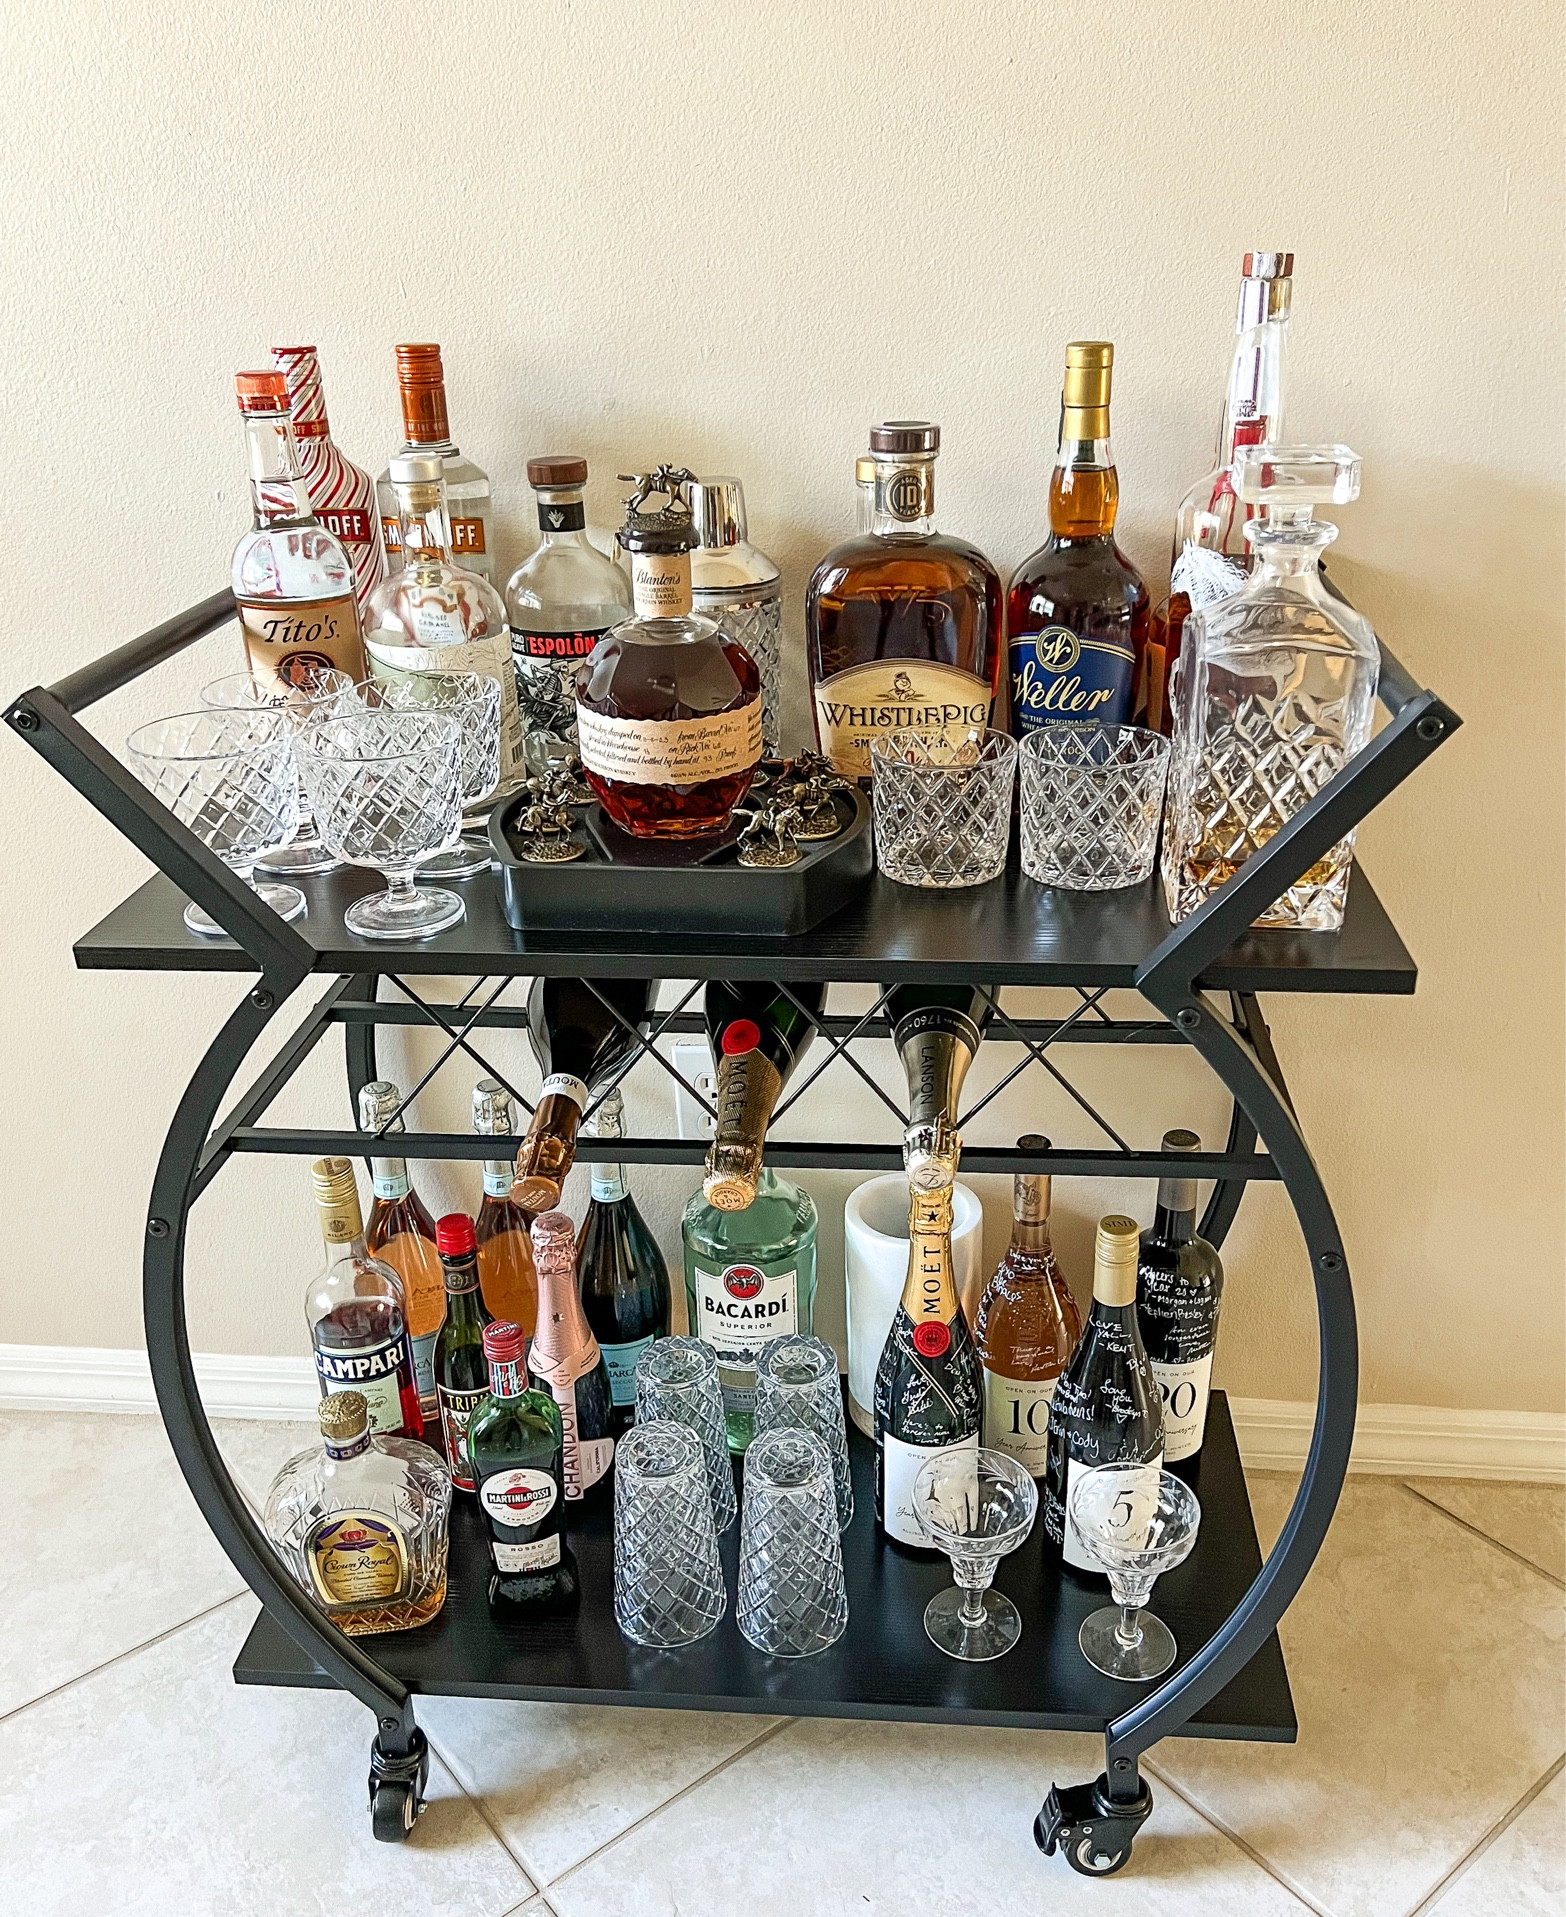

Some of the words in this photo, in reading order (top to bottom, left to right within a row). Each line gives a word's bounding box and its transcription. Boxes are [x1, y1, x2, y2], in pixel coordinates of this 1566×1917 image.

[900, 486, 918, 507] 10
[636, 569, 681, 585] Blanton's
[1013, 661, 1115, 711] Weller
[1030, 715, 1042, 724] THE
[914, 1014, 941, 1028] 1760
[920, 1045, 935, 1105] LANSON
[722, 1061, 748, 1127] MOËT
[1105, 1220, 1133, 1229] SIMI
[921, 1246, 941, 1314] MOËT
[1180, 1277, 1189, 1286] to
[705, 1293, 787, 1319] BACARDÍ
[487, 1323, 519, 1337] MARTINI
[720, 1321, 773, 1330] SUPERIOR
[314, 1341, 404, 1379] CAMPARI
[1006, 1399, 1052, 1435] 10
[560, 1403, 582, 1498] CHANDON
[1071, 1431, 1099, 1459] Cody
[907, 1452, 927, 1460] OPEN
[1107, 1490, 1134, 1528] 5
[511, 1543, 544, 1552] ROSSO
[324, 1559, 357, 1574] Crown
[350, 1555, 394, 1572] Royal
